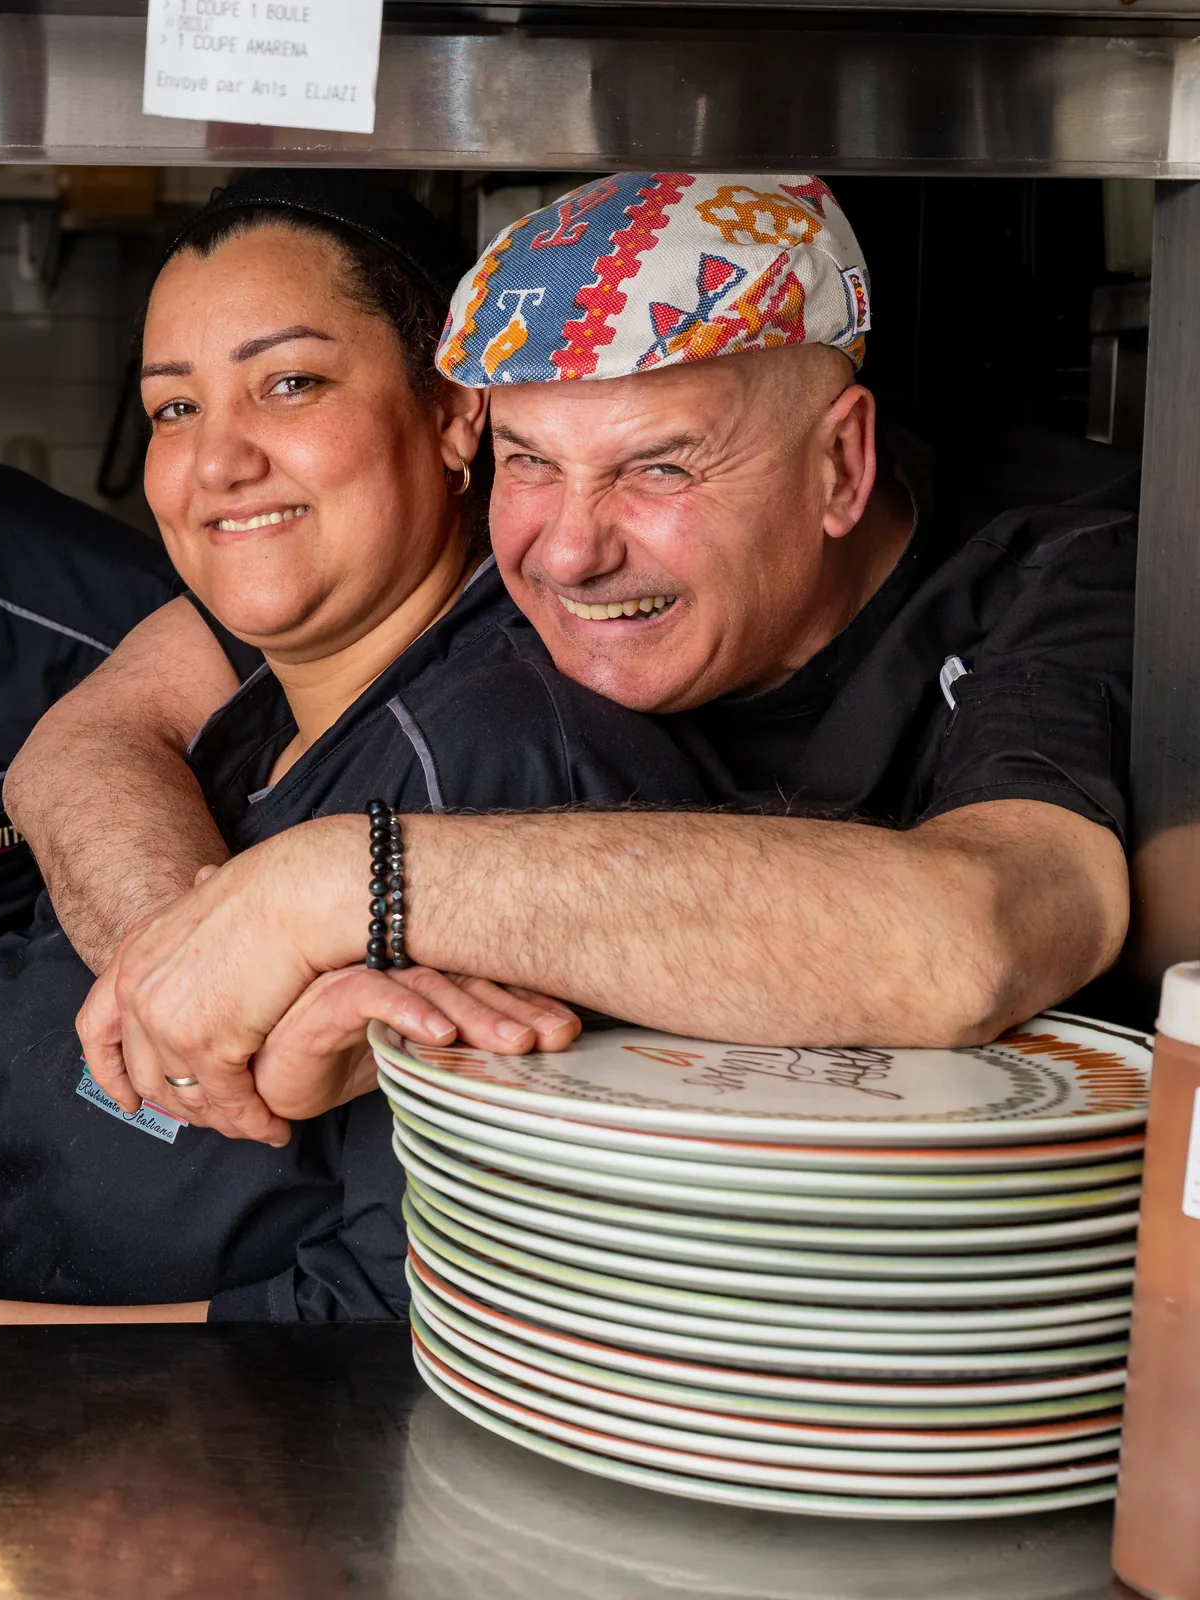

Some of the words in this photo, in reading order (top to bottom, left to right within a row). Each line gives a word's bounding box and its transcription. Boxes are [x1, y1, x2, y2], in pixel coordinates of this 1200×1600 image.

[196, 0, 241, 18] COUPE
[266, 3, 311, 23] BOULE
[193, 33, 240, 54] COUPE
[246, 37, 308, 58] AMARENA
[157, 70, 208, 92] Envoyé
[216, 79, 243, 94] par
[251, 79, 287, 98] Anis
[304, 81, 358, 103] ELJAZI
[123, 1108, 174, 1139] Italiana
